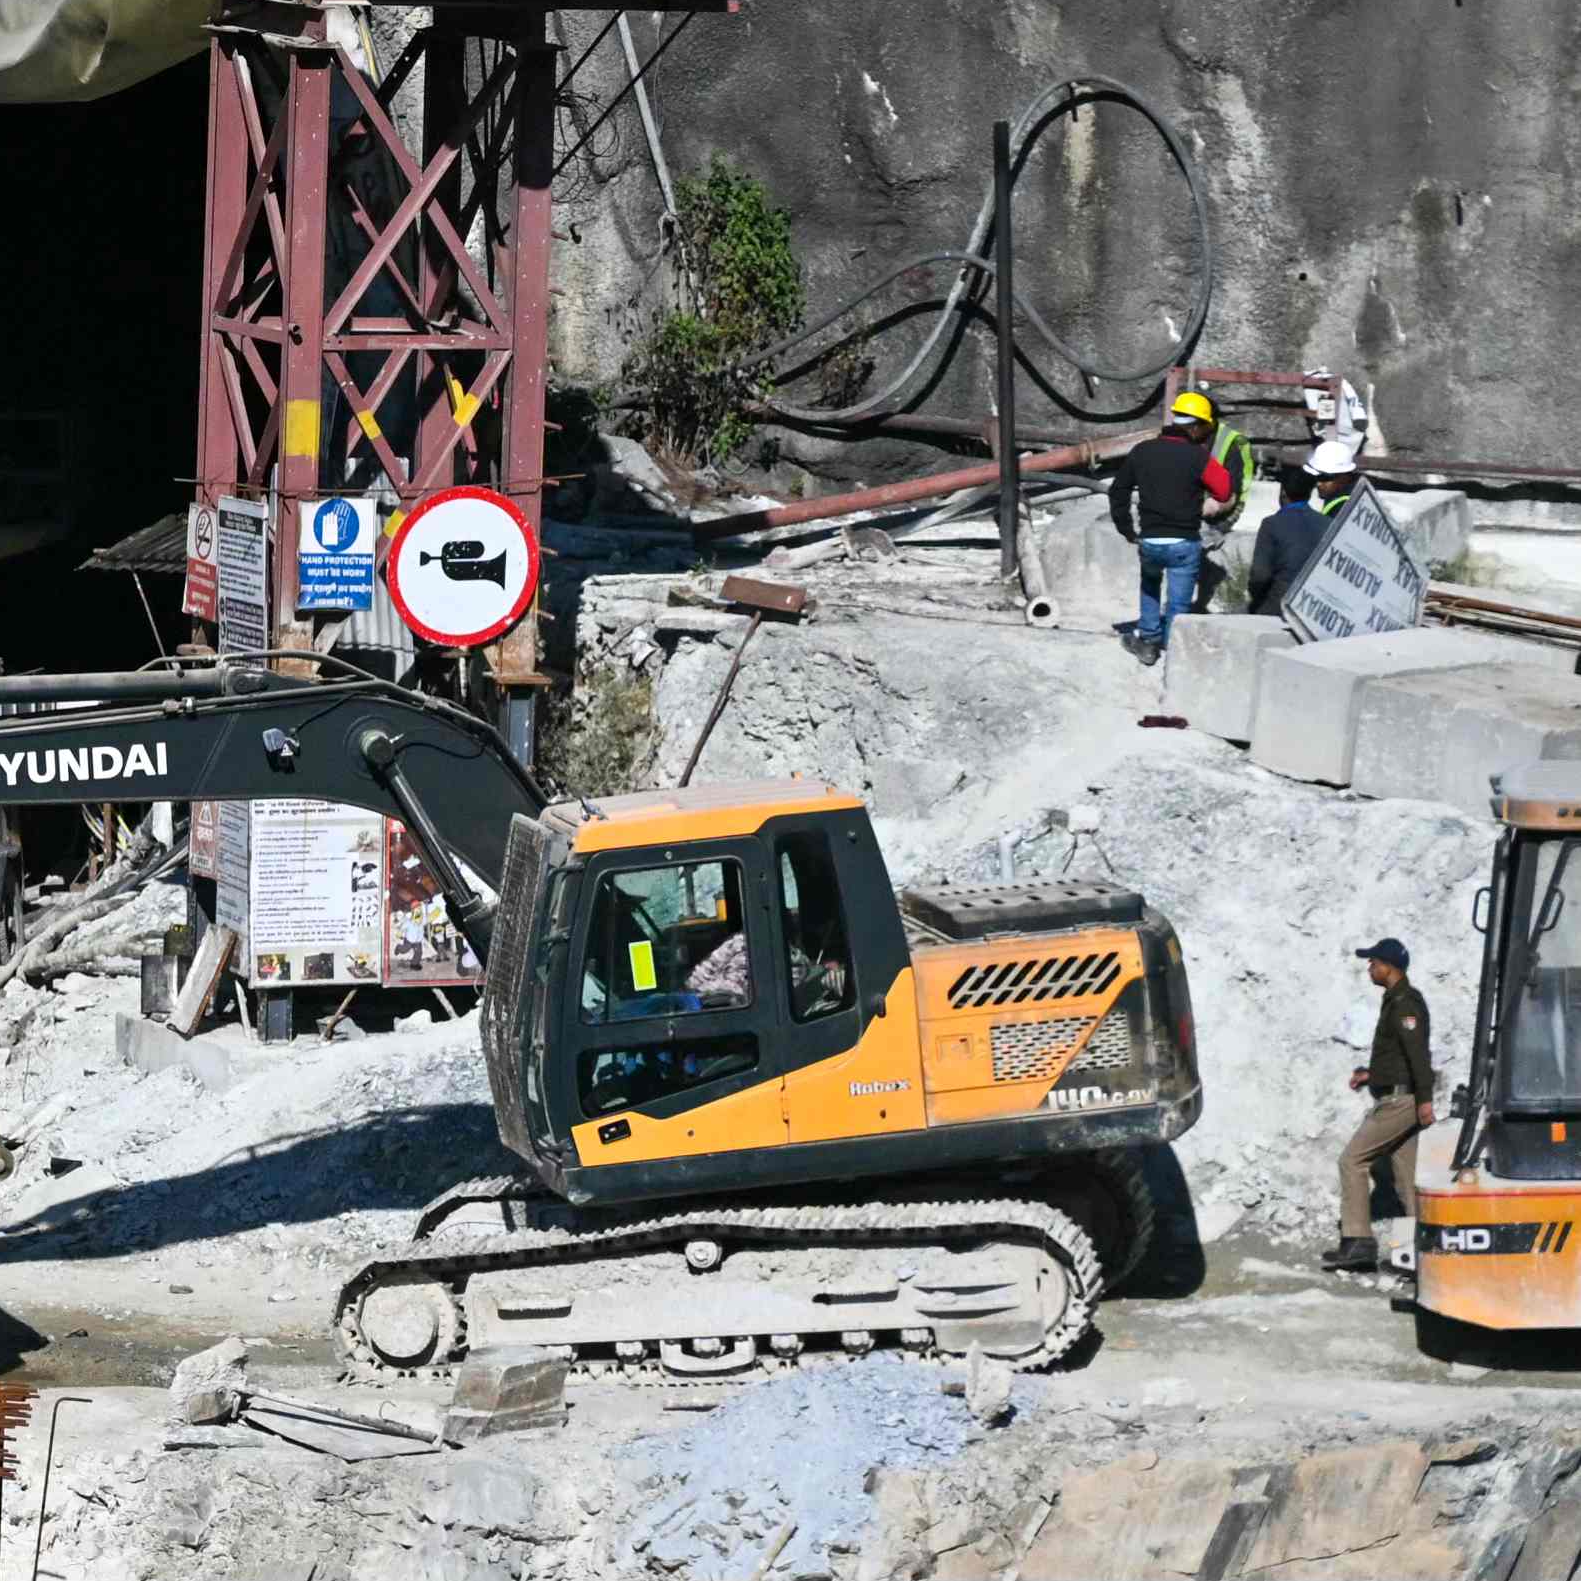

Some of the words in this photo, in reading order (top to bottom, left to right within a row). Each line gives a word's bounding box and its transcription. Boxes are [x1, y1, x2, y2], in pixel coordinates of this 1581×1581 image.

[324, 555, 373, 566] PROTECTION
[1324, 546, 1384, 599] ALOMAX
[1297, 589, 1356, 639] ALOMAX
[849, 1079, 909, 1097] Robex
[1441, 1228, 1491, 1251] HD
